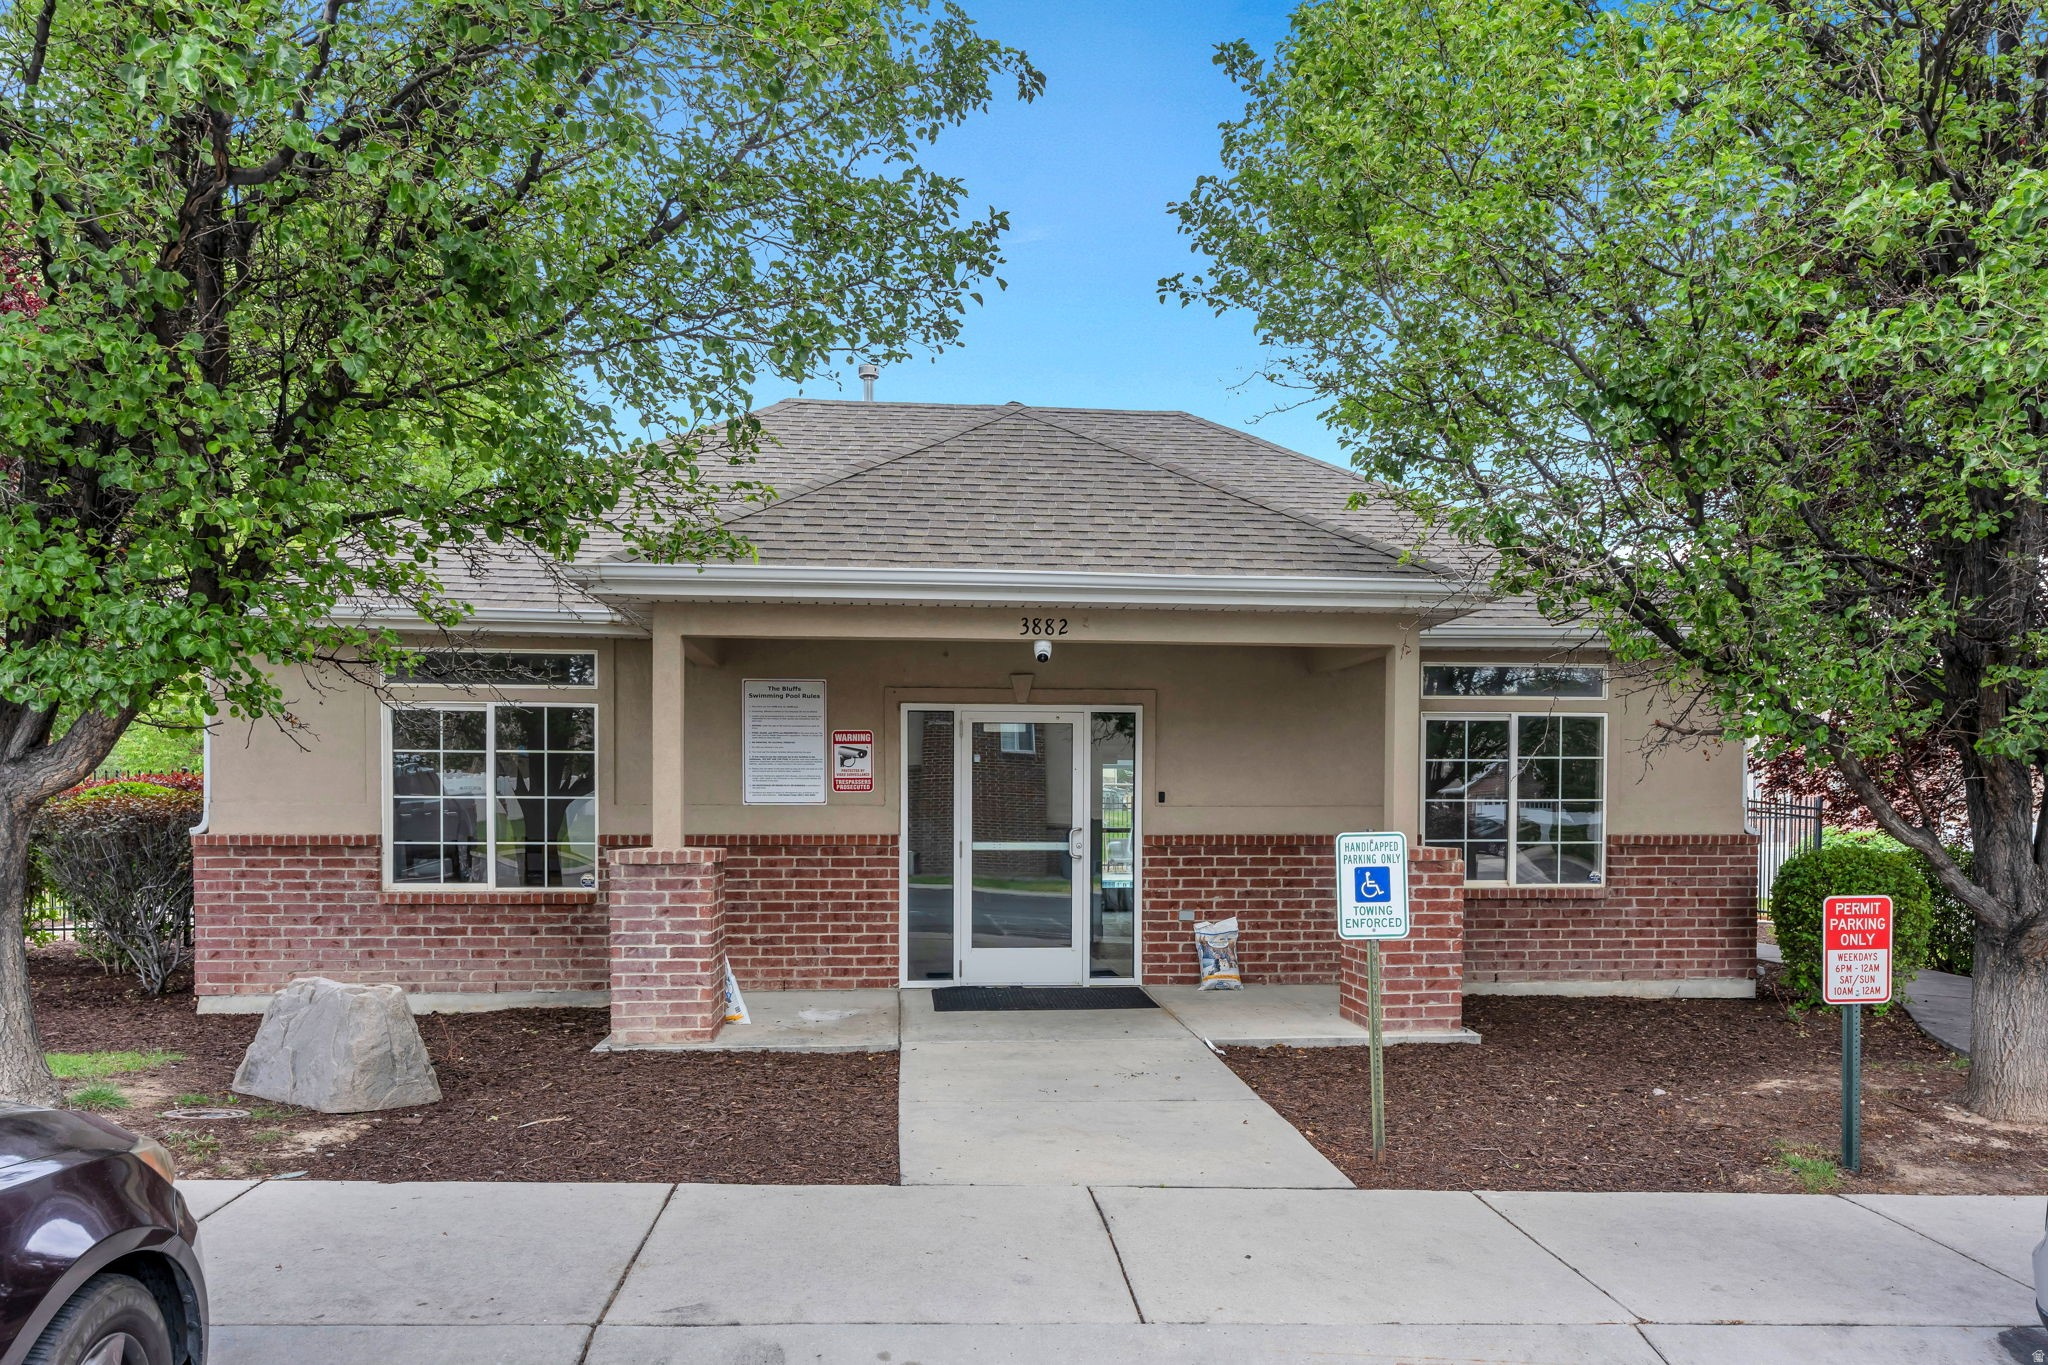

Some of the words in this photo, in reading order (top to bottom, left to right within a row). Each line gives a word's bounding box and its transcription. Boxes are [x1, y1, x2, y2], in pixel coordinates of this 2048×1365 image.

[1020, 617, 1068, 635] 3882
[834, 733, 871, 742] WARNING
[1344, 841, 1399, 852] HANDICAPPED
[1343, 854, 1377, 865] PARKING
[1381, 853, 1401, 864] ONLY
[1353, 905, 1393, 916] TOWING
[1835, 902, 1881, 915] PERMIT
[1345, 917, 1402, 928] ENFORCED
[1829, 918, 1886, 931] PARKING
[1840, 933, 1875, 946] ONLY
[1837, 952, 1878, 962] WEEKDAYS
[1835, 964, 1852, 973] 6PM
[1861, 964, 1880, 972] 12AM
[1839, 974, 1876, 987] SAT/SUN
[1834, 987, 1854, 996] 10AM
[1862, 986, 1881, 995] 12AM
